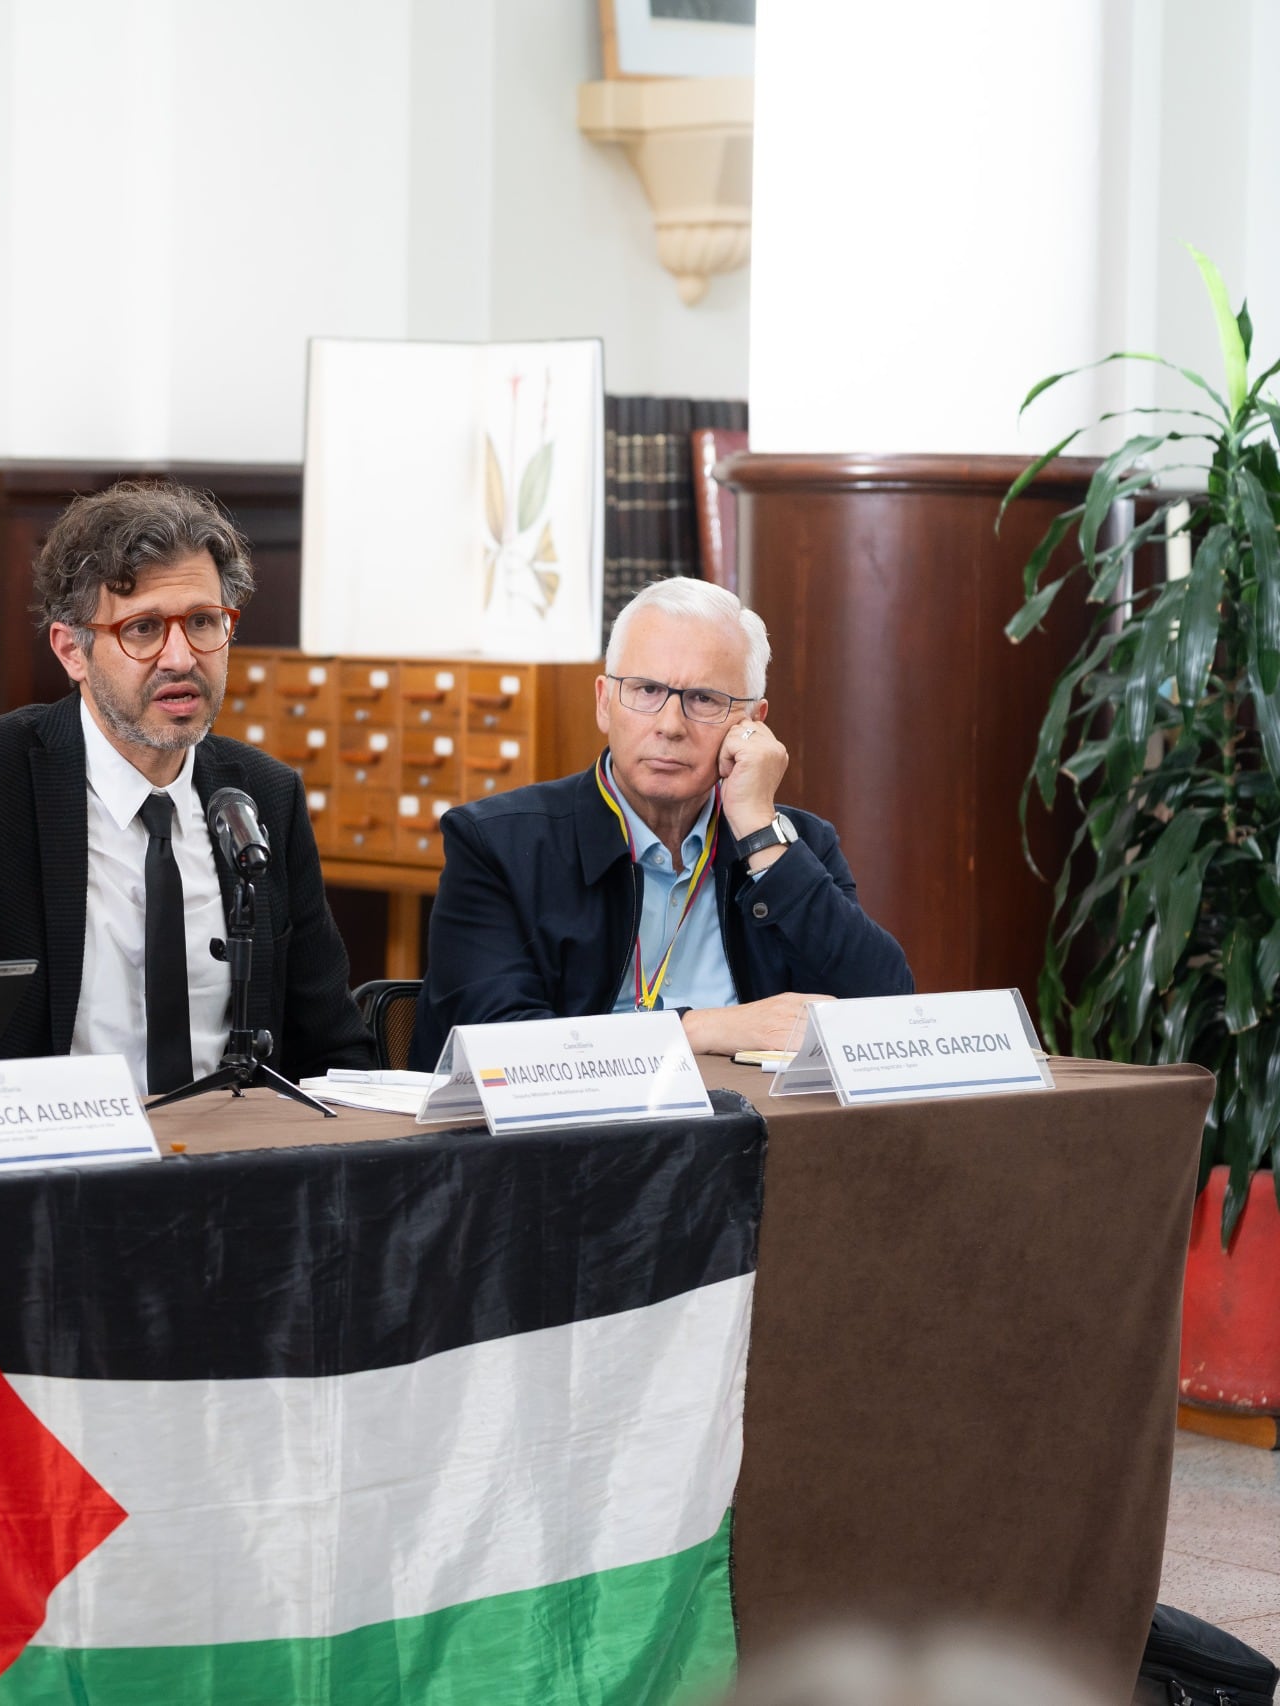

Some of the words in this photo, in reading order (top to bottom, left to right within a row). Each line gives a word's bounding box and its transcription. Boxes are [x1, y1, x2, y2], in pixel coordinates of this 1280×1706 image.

[842, 1039, 933, 1062] BALTASAR
[936, 1033, 1011, 1055] GARZON
[504, 1062, 573, 1085] MAURICIO
[577, 1057, 646, 1080] JARAMILLO
[37, 1098, 134, 1123] ALBANESE
